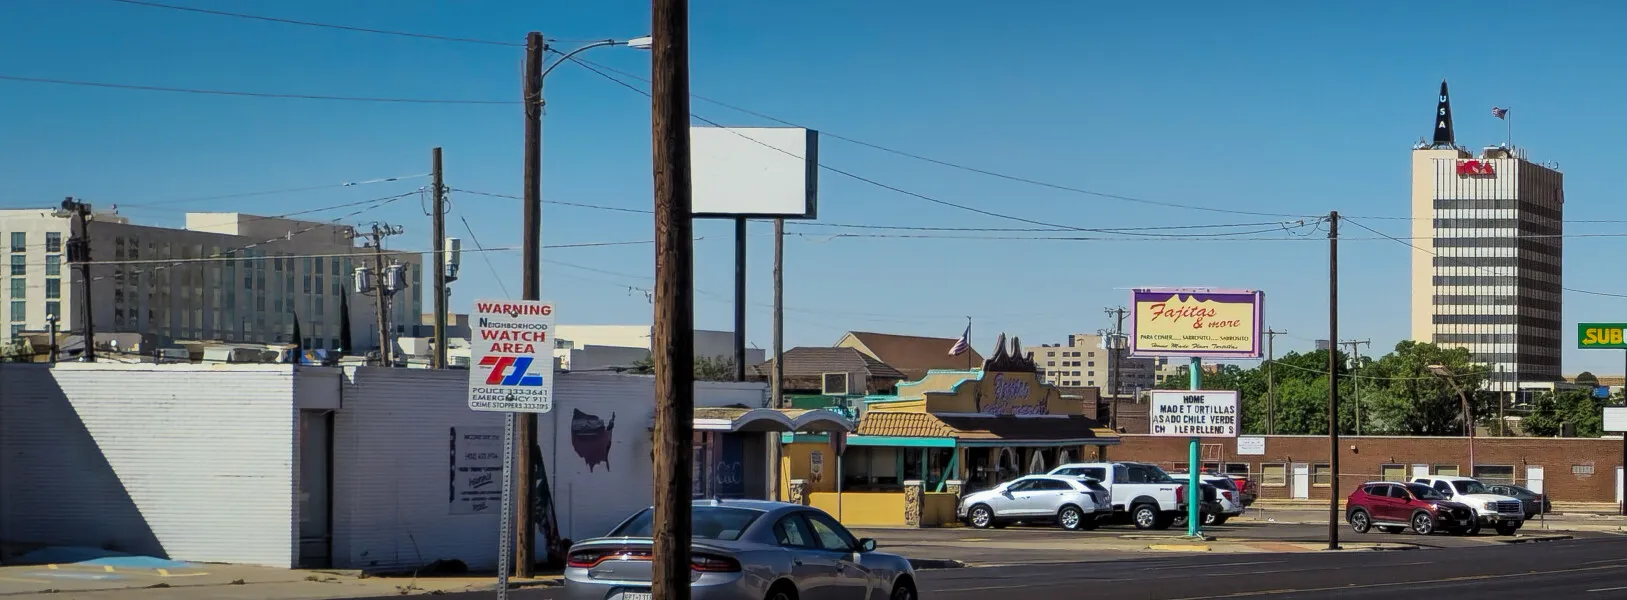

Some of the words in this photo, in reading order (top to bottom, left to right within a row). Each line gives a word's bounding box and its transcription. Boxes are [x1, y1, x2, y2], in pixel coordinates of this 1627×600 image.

[1438, 95, 1447, 128] USA
[477, 302, 552, 316] WARNING
[1149, 303, 1217, 323] Fajitas
[1192, 317, 1203, 329] &
[1208, 319, 1241, 329] more
[481, 330, 546, 342] WATCH
[490, 343, 535, 354] AREA
[472, 387, 504, 395] POLICE
[1183, 395, 1205, 404] HOME
[1152, 415, 1181, 424] ASADO
[1183, 415, 1206, 424] CHILE
[1210, 415, 1235, 424] VERDE
